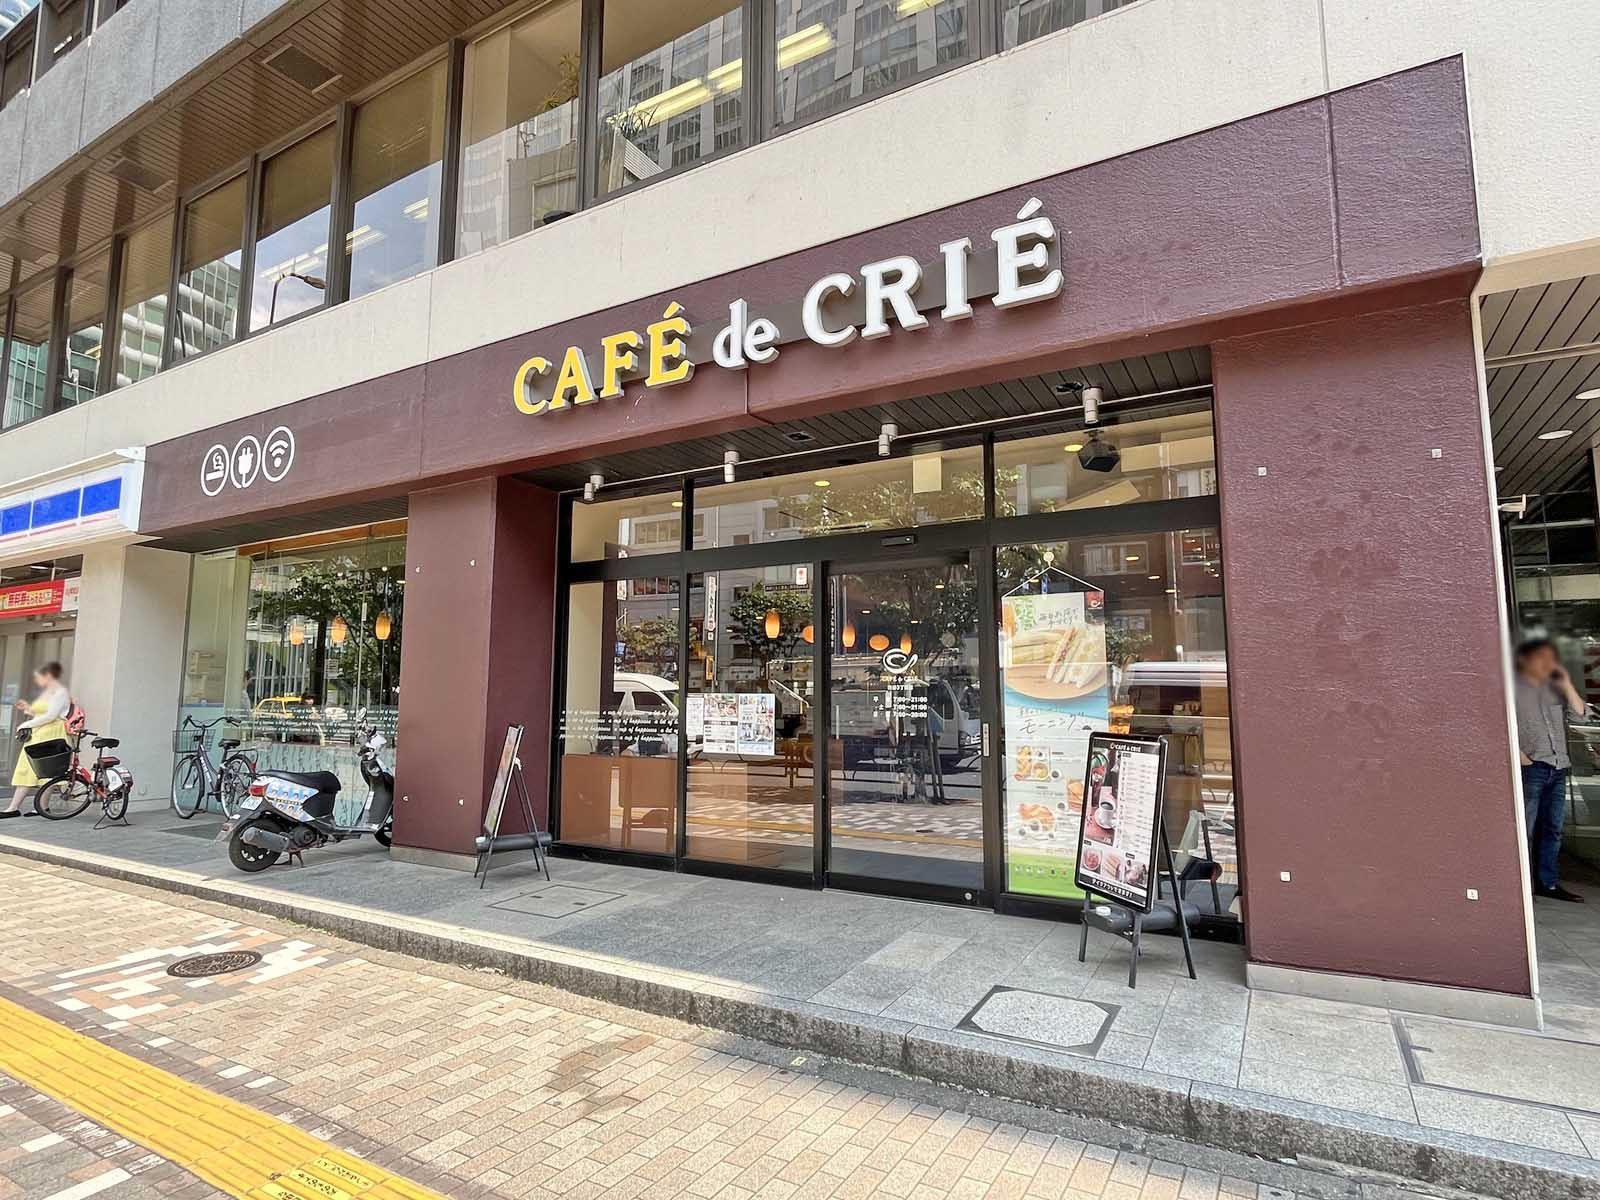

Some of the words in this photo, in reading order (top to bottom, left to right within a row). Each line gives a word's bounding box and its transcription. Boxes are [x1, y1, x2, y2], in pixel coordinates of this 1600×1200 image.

[513, 301, 695, 415] CAFÉ
[712, 298, 781, 369] de
[802, 197, 1064, 347] CRIÉ
[635, 726, 657, 734] happiness
